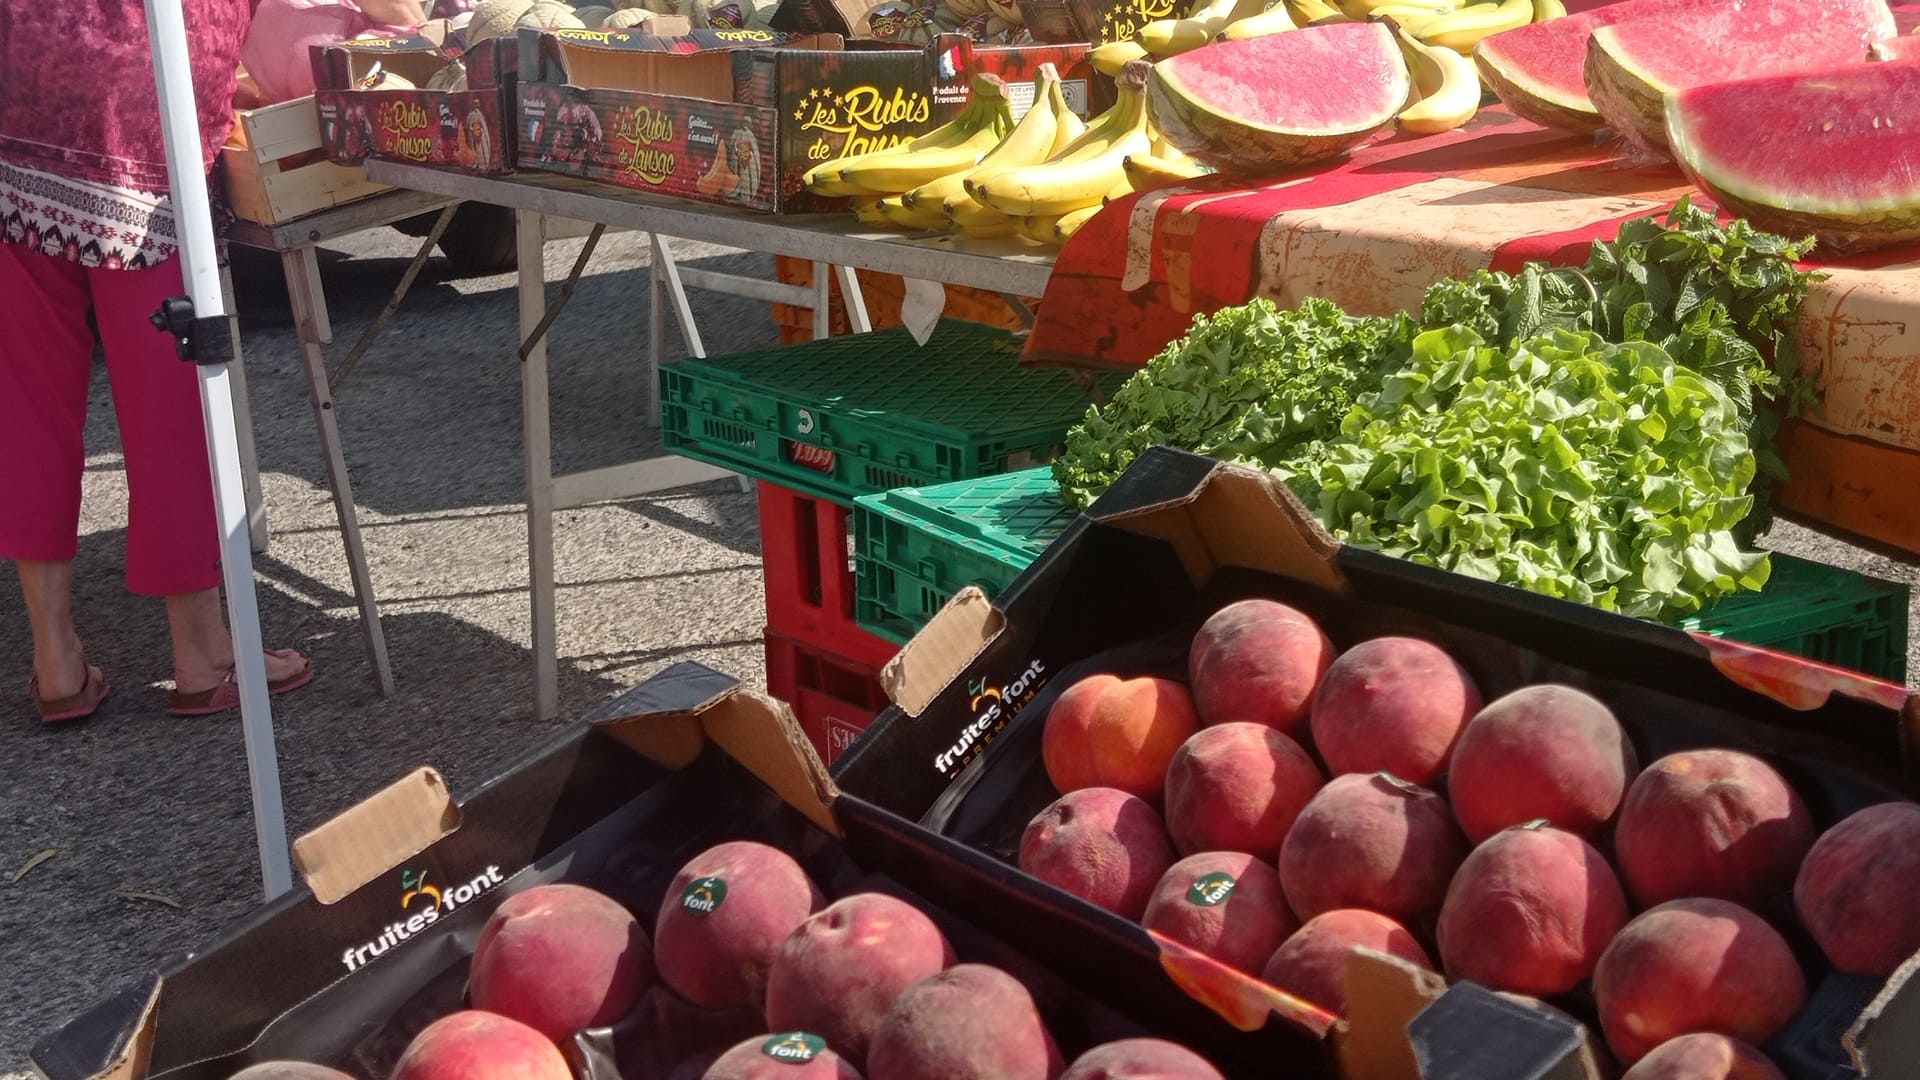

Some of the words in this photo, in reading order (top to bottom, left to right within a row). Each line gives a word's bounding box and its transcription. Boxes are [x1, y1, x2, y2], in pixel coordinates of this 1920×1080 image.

[392, 100, 428, 133] Rubis
[633, 105, 673, 145] Rubis
[801, 102, 840, 131] Les
[843, 86, 929, 131] Rubis
[808, 137, 832, 160] de
[935, 704, 1001, 773] fruites
[1001, 658, 1045, 704] font
[684, 894, 715, 912] font
[1205, 880, 1235, 904] font
[342, 906, 439, 971] fruites
[442, 864, 503, 911] font
[769, 1045, 812, 1059] font
